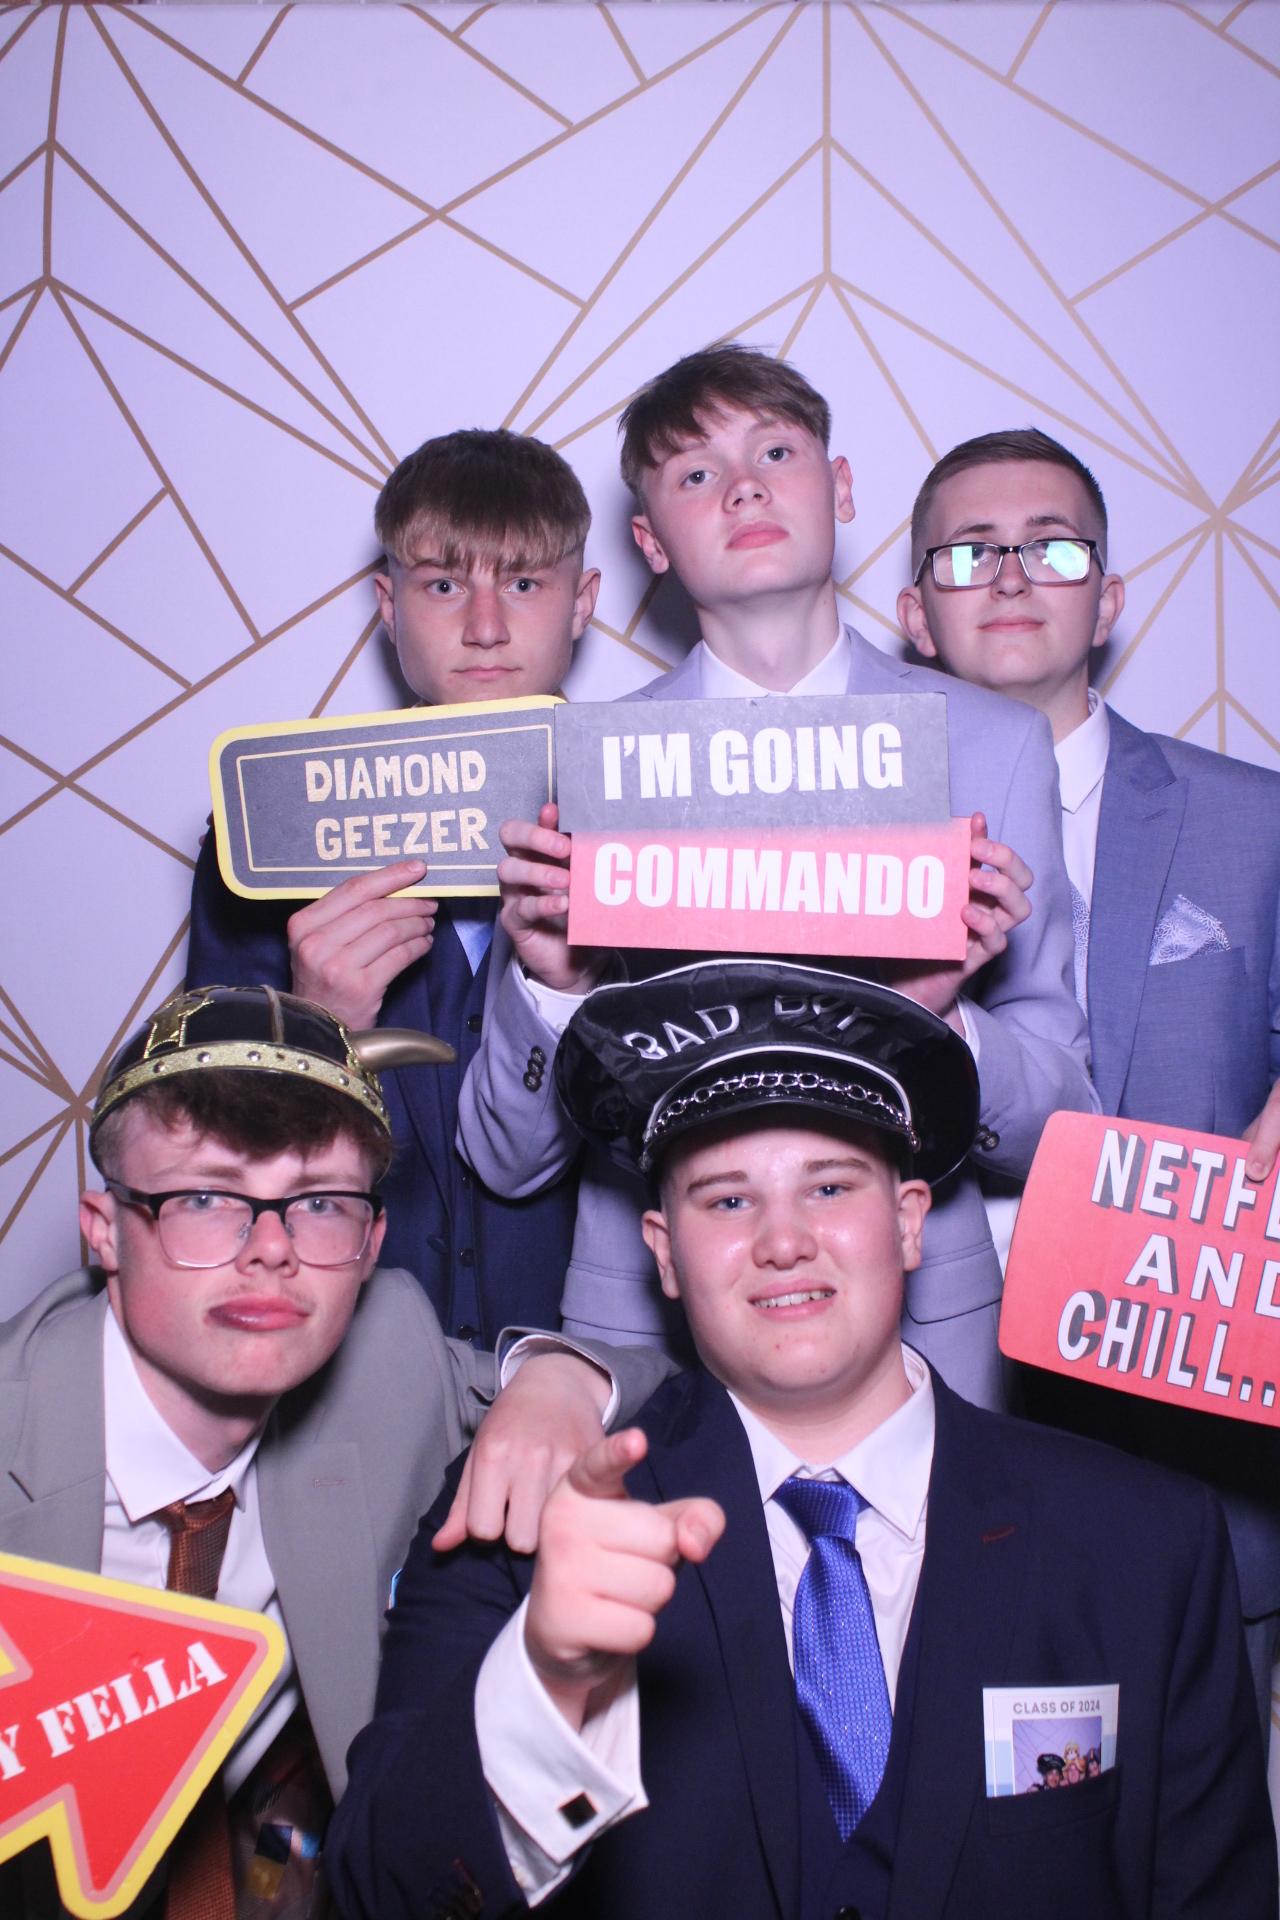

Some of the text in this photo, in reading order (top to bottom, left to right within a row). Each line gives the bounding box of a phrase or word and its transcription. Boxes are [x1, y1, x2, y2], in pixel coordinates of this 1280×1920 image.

[305, 750, 488, 803] DIAMOND
[601, 722, 903, 801] I'M GOING
[315, 808, 490, 861] GEEZER
[593, 843, 946, 919] COMMANDO
[622, 1004, 740, 1059] BAD
[36, 1640, 228, 1758] FELLA
[1013, 1699, 1100, 1715] CLASS OF 2024
